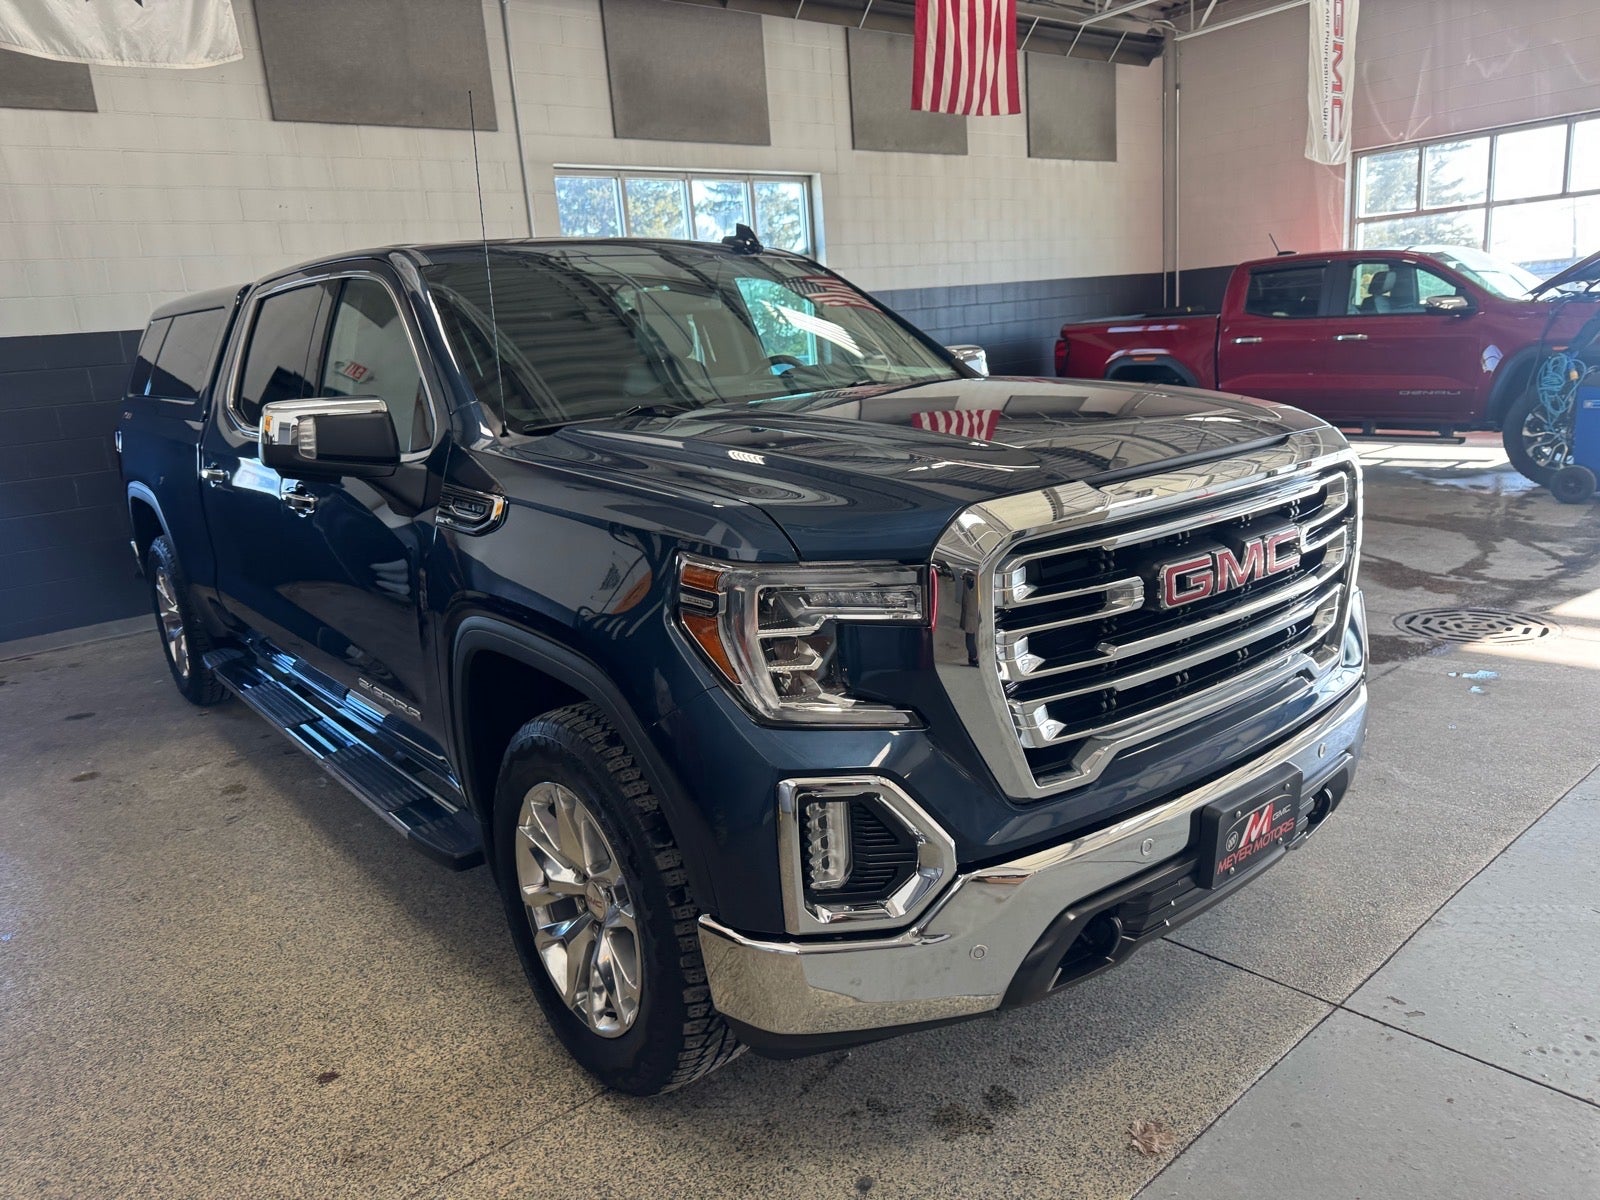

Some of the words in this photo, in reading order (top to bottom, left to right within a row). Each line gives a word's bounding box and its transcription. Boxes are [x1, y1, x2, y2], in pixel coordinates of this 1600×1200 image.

[1331, 0, 1345, 142] GMC
[1160, 523, 1300, 609] GMC
[1217, 844, 1253, 875] MEYER
[1253, 817, 1295, 853] MOTORS
[1272, 804, 1292, 821] GMC
